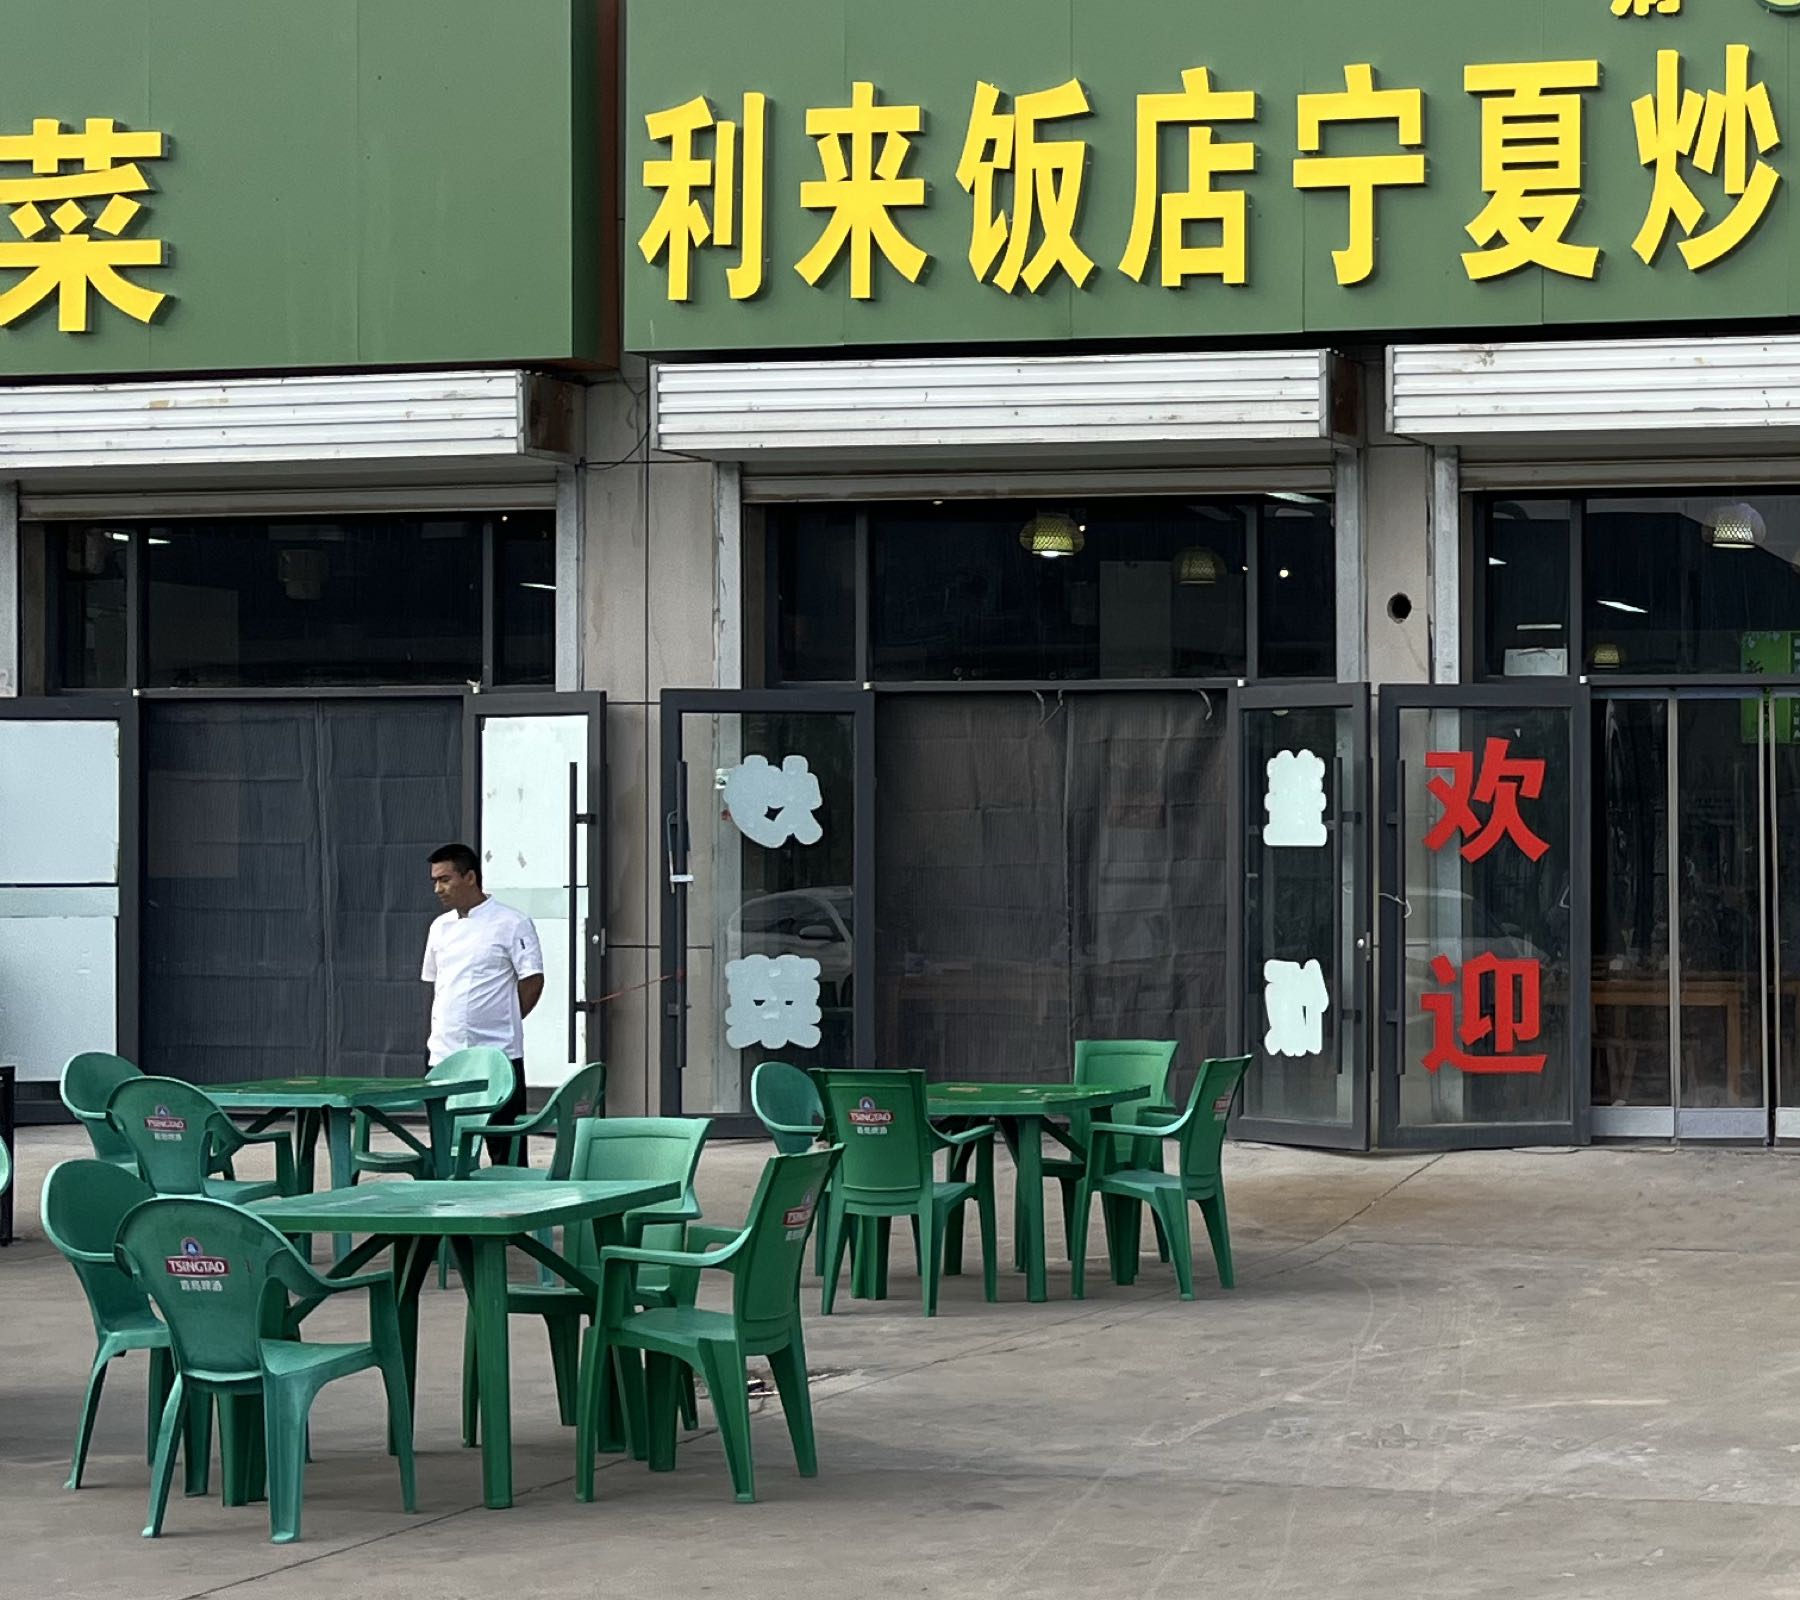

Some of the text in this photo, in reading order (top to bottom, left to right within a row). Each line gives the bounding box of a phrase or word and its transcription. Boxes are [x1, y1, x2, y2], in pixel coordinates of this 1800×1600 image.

[0, 117, 167, 333] 菜
[1421, 736, 1550, 1076] 欢迎
[167, 1260, 226, 1273] TSINGTAO
